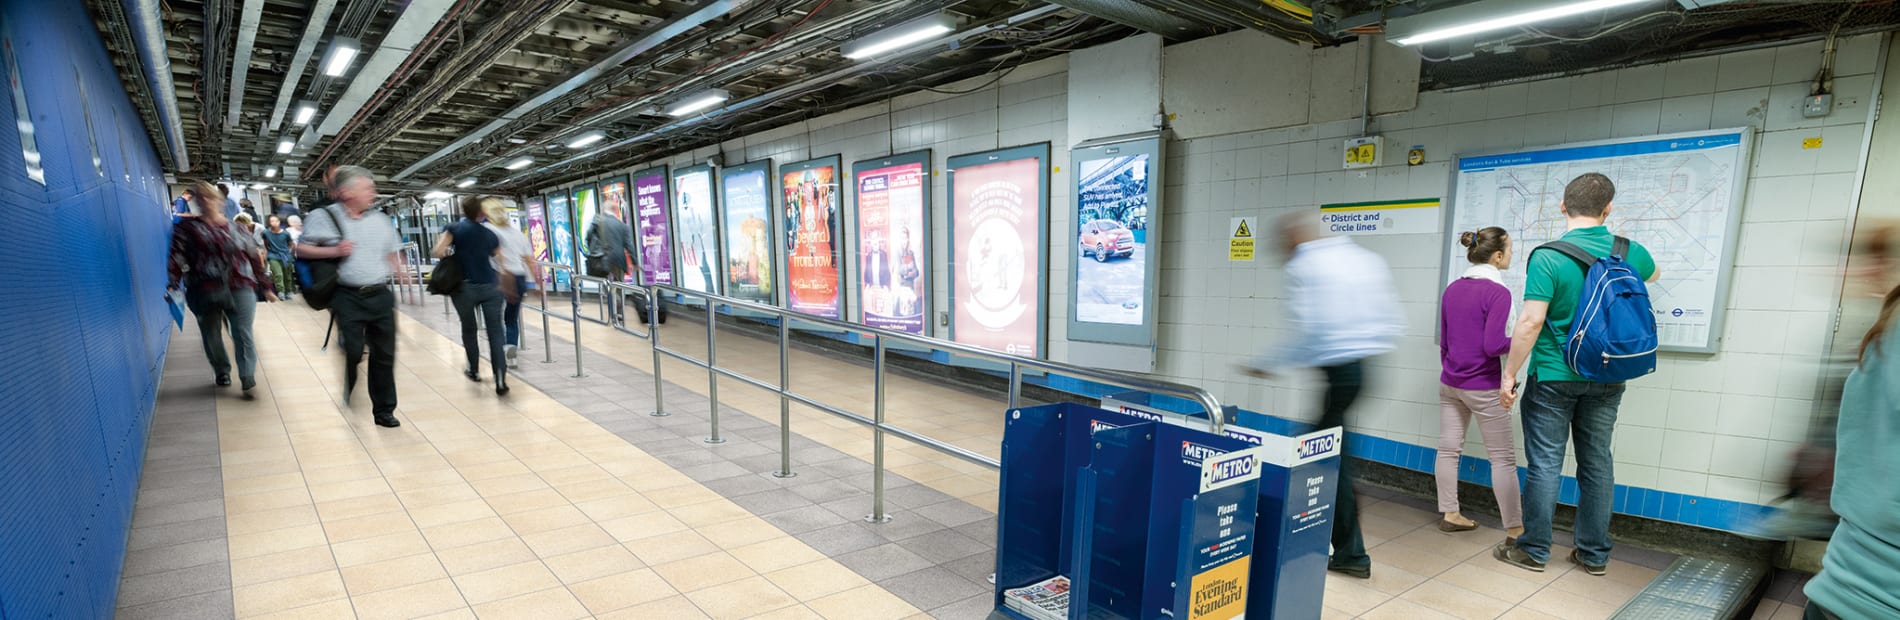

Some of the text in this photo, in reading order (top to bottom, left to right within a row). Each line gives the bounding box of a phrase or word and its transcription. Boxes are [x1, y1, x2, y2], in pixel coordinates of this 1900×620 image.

[1331, 212, 1380, 222] District and
[1330, 223, 1377, 232] Circle lines
[1184, 443, 1223, 460] METR
[1300, 436, 1333, 458] METRO
[1212, 456, 1252, 482] METRO
[1306, 475, 1324, 488] Please
[1308, 486, 1320, 497] take
[1308, 497, 1318, 507] one
[1217, 503, 1238, 517] Please
[1219, 515, 1234, 527] take
[1219, 527, 1231, 539] one
[1195, 577, 1238, 604] Evening
[1202, 579, 1222, 590] London
[1193, 586, 1242, 619] Standard
